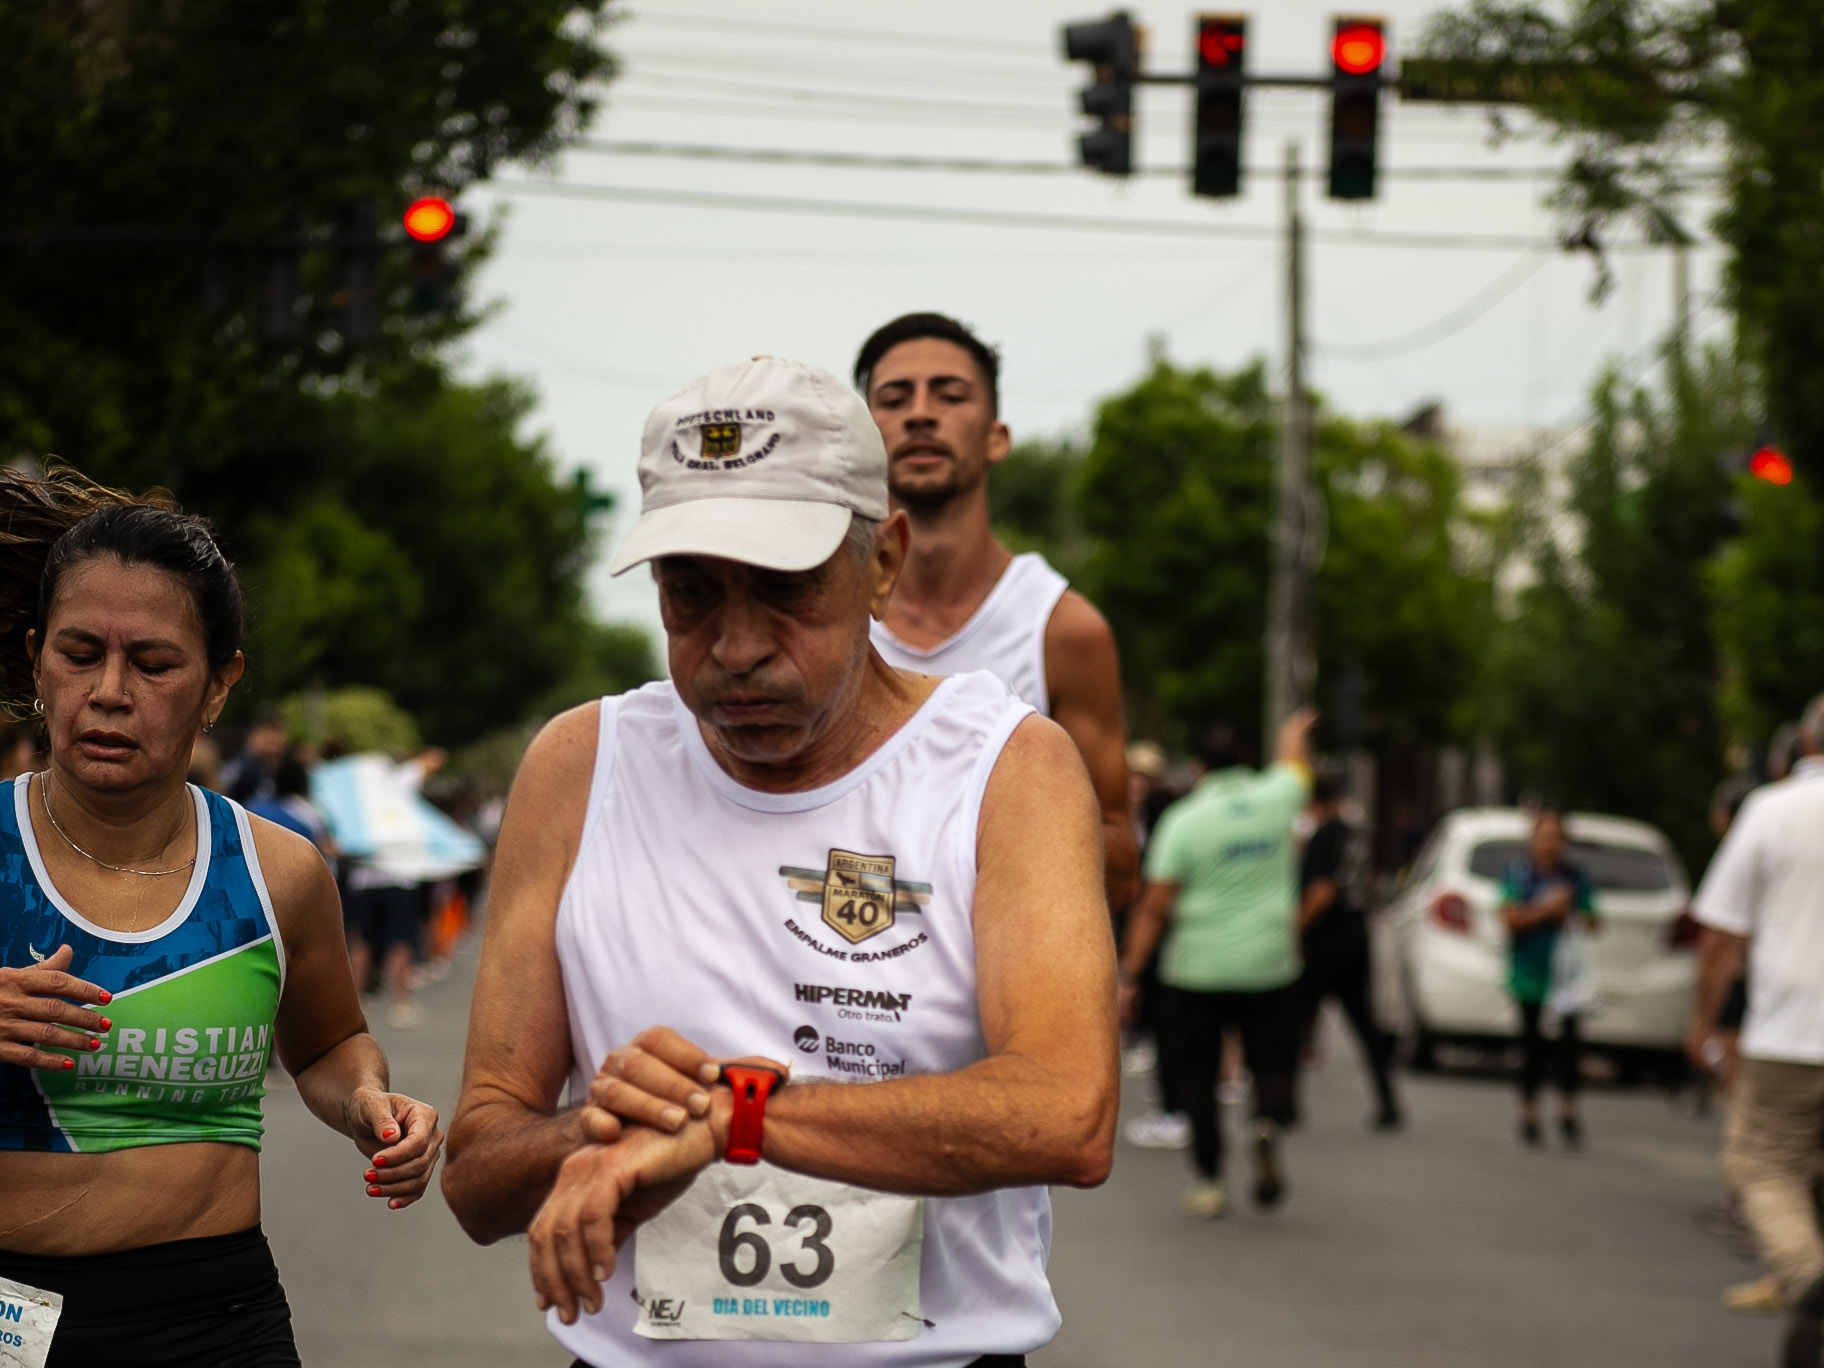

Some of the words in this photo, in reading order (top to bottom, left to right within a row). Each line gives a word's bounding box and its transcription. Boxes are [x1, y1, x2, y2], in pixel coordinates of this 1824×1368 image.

[836, 858, 890, 873] ARGENTINA
[836, 899, 879, 928] 40
[784, 919, 848, 961] EMPALME
[850, 932, 928, 962] GRANEROS
[794, 983, 912, 1012] HIPERMAT
[838, 1008, 863, 1021] Otro
[825, 1036, 875, 1057] Banco
[77, 1050, 264, 1081] MENEGUZZI
[827, 1056, 905, 1077] Municipal
[74, 1081, 205, 1103] RUNNING
[219, 1082, 258, 1102] TEAM
[718, 1203, 835, 1289] 63
[713, 1298, 739, 1315] DIA
[743, 1298, 769, 1316] DEL
[774, 1299, 831, 1318] VECINO
